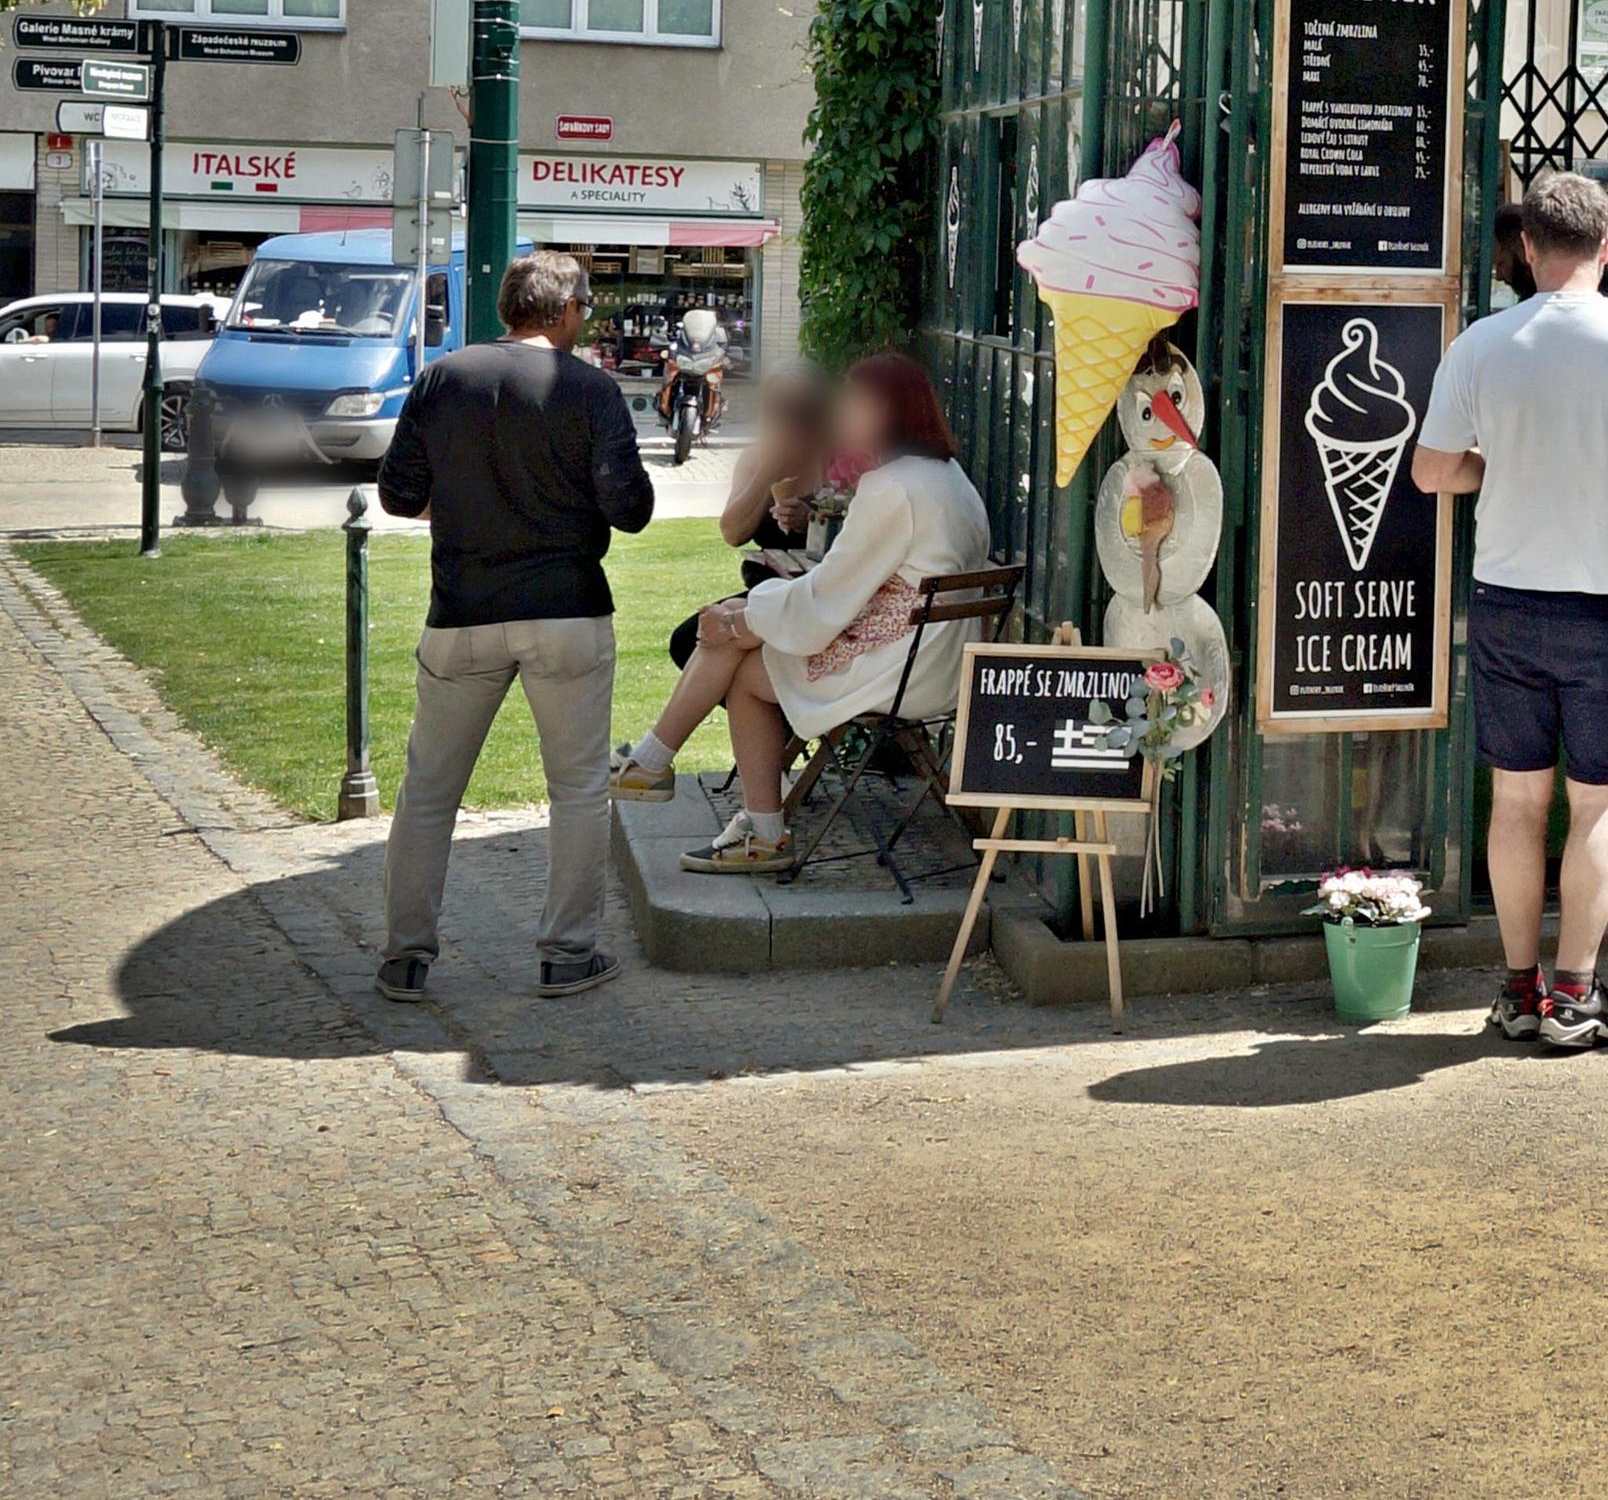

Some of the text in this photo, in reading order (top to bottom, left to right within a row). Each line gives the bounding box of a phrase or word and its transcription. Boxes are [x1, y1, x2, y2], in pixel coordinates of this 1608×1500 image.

[20, 21, 134, 40] Galerie Masné krámy
[1304, 19, 1378, 39] TOČENÁ ZMRZLINA
[32, 64, 75, 76] Pivovar
[84, 112, 100, 122] WC
[193, 150, 297, 179] ITALSKÉ
[532, 160, 685, 188] DELIKATESY
[571, 190, 646, 203] A SPECIALITY
[1294, 580, 1416, 620] SOFT SERVE
[1295, 632, 1412, 673] ICE CREAM
[980, 663, 1143, 700] FRAPPÉ SE ZMRZLINO
[992, 723, 1037, 764] 85,-
